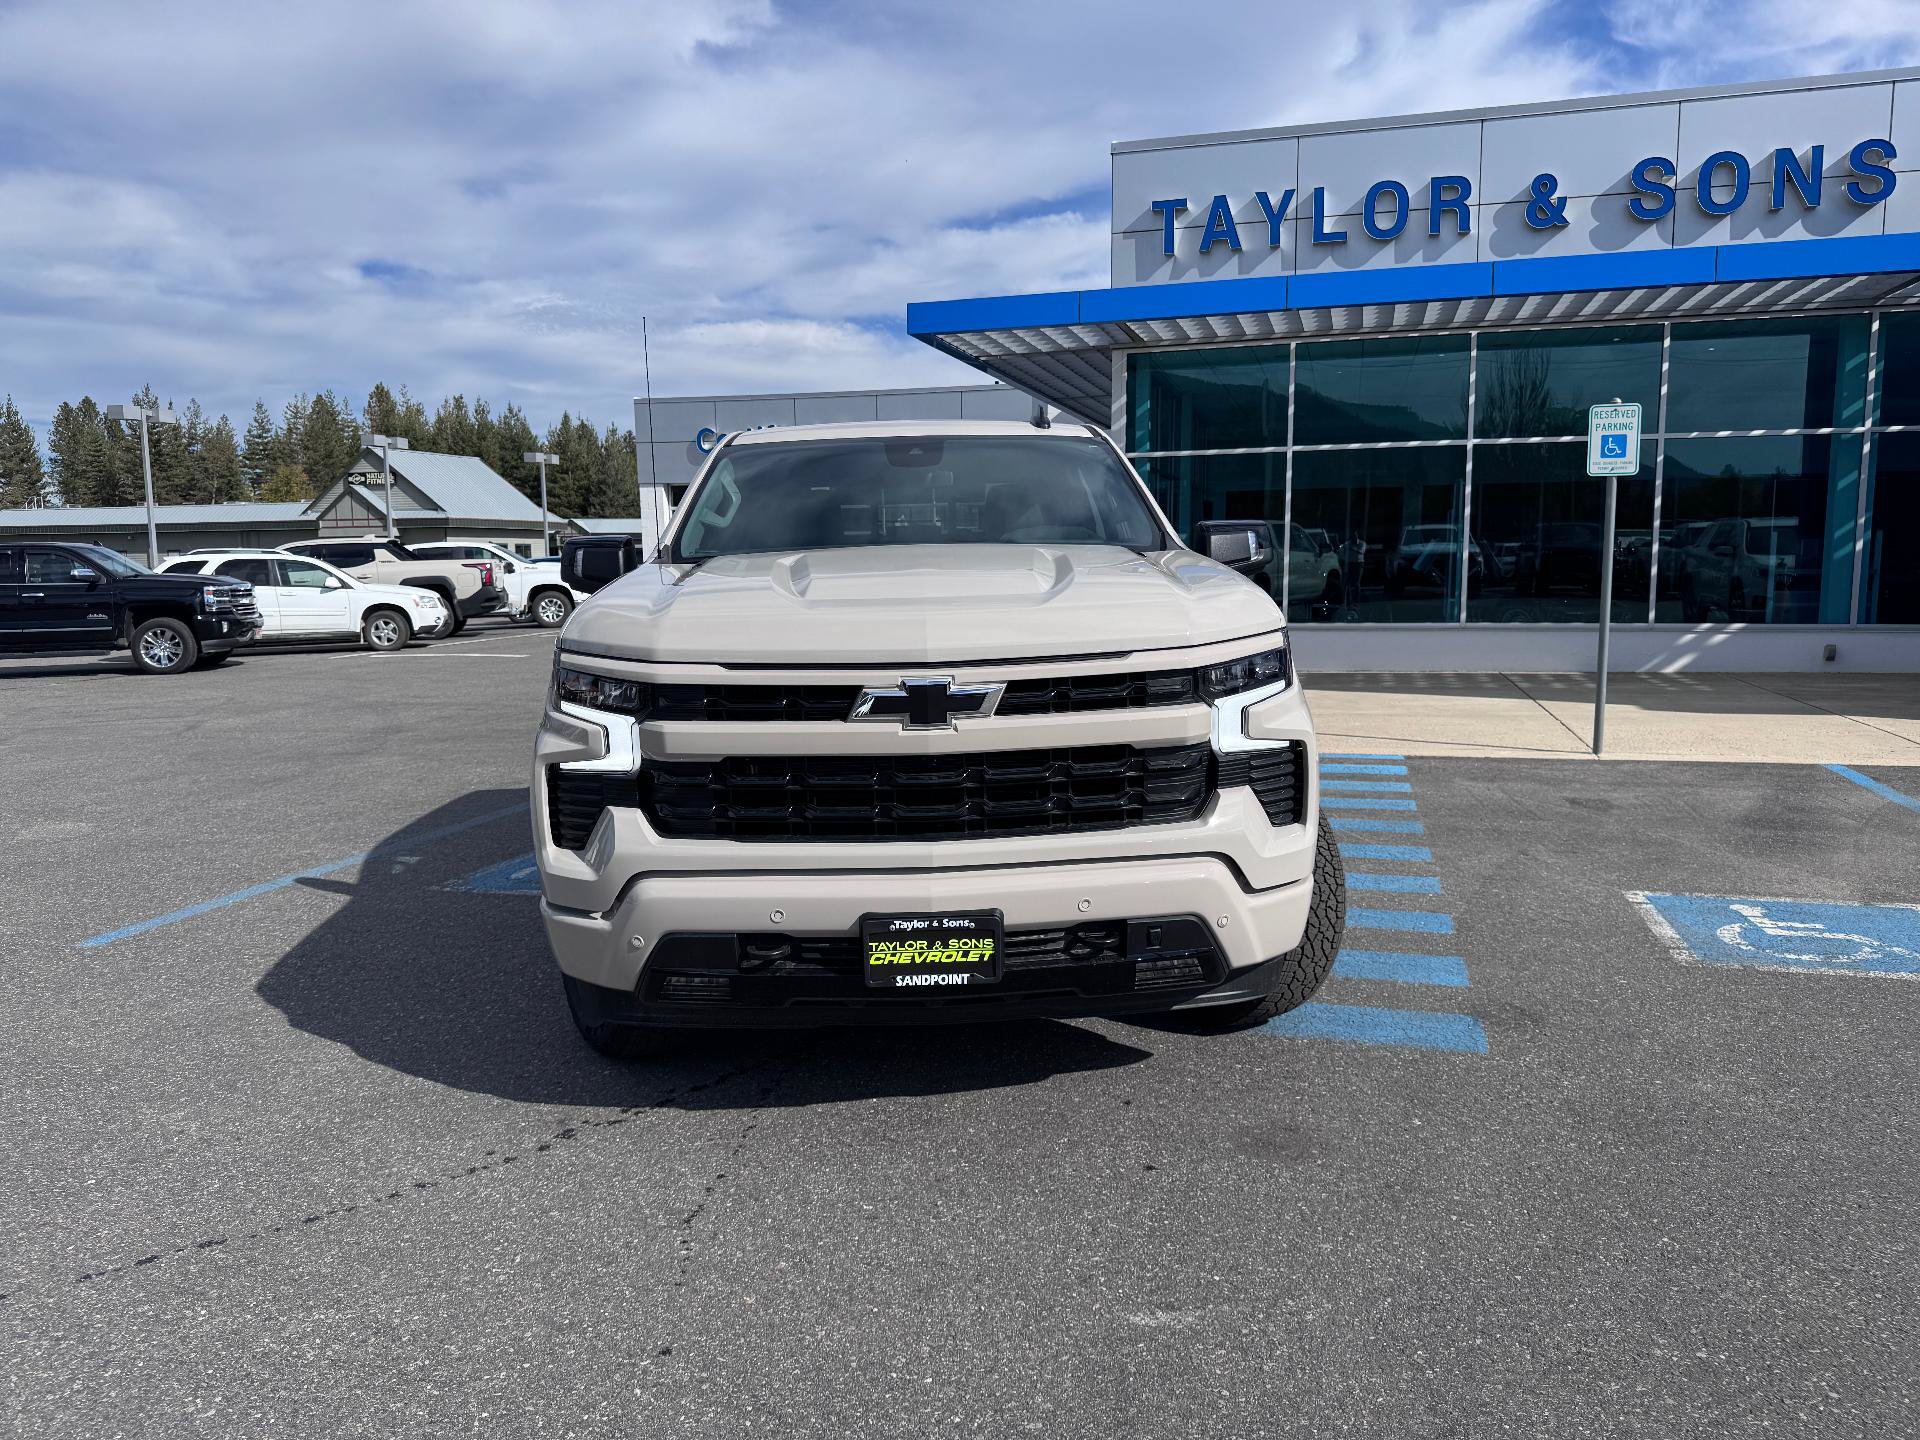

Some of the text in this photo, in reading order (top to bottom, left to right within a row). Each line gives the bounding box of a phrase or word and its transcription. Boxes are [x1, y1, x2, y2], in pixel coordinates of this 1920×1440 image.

[1151, 138, 1898, 255] TAYLOR & SONS
[1594, 409, 1636, 419] RESERVED
[1595, 422, 1634, 431] PARKING
[893, 920, 930, 931] Taylor
[942, 918, 970, 928] Sons
[868, 938, 995, 952] TAYLOR & SONS
[869, 950, 995, 965] CHEVROLET
[895, 974, 970, 987] SANDPOINT
